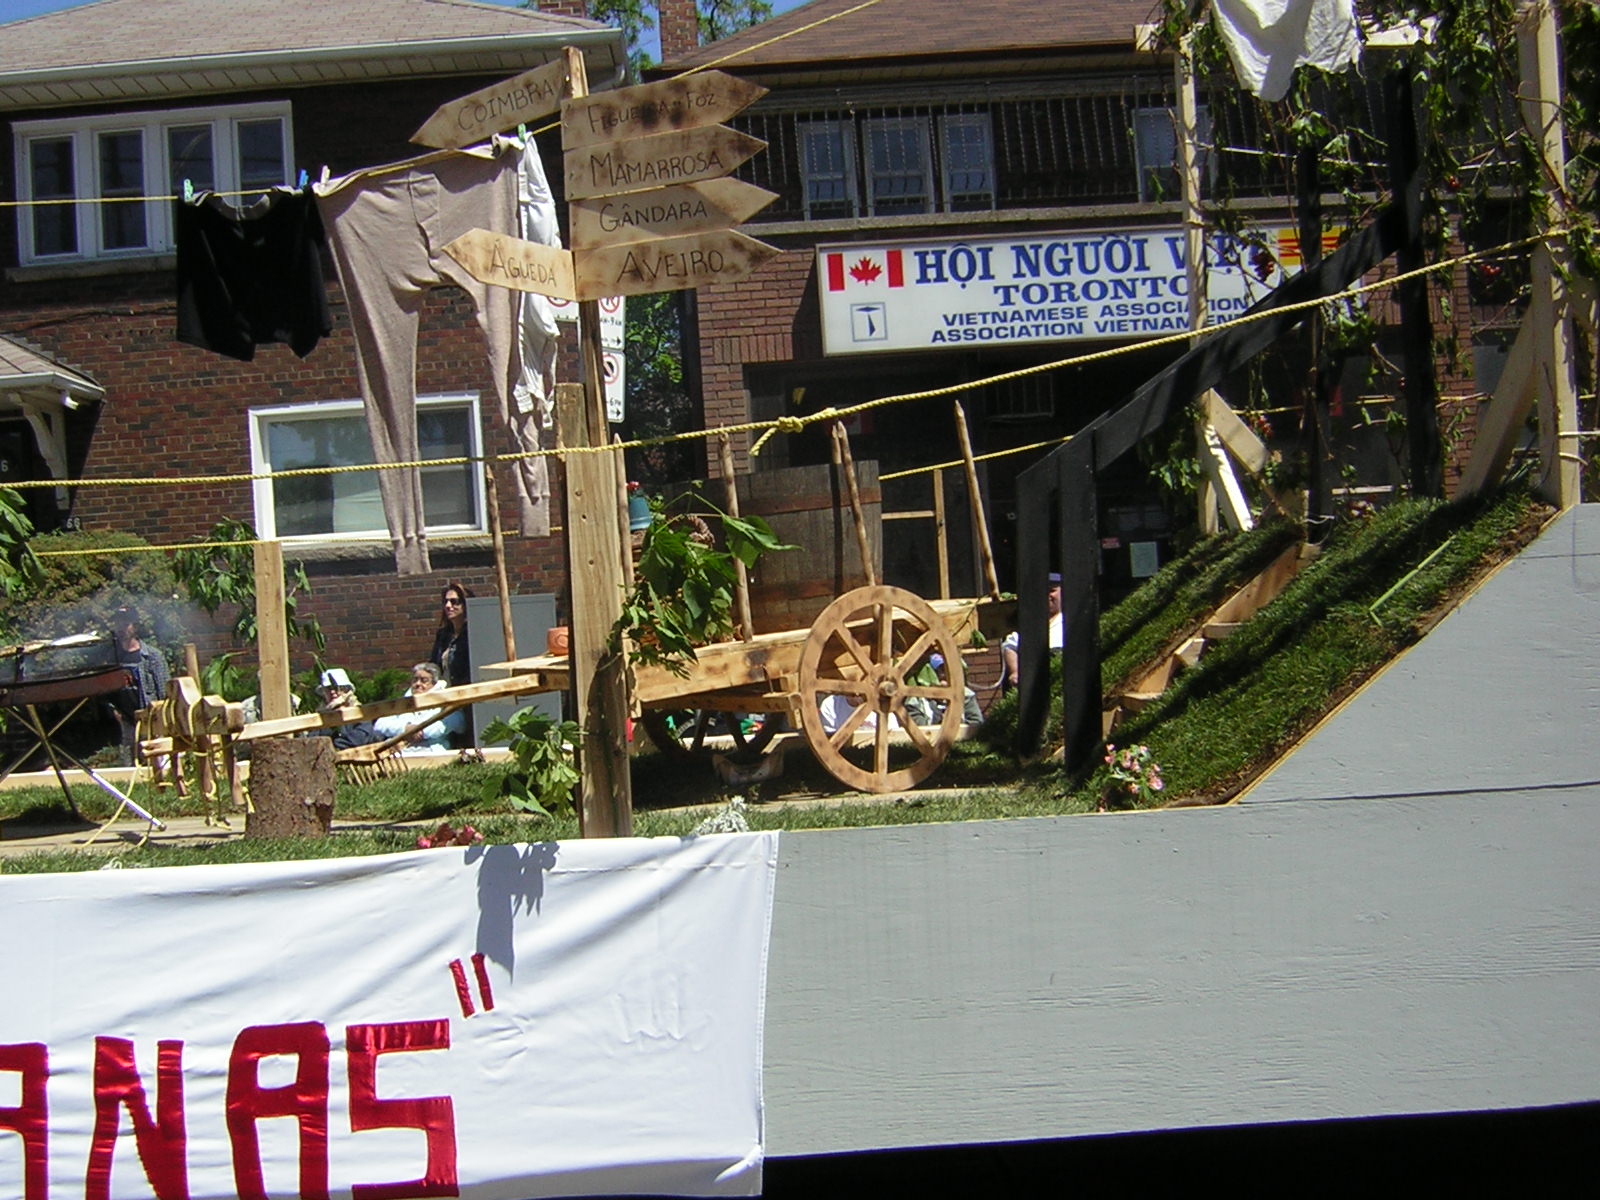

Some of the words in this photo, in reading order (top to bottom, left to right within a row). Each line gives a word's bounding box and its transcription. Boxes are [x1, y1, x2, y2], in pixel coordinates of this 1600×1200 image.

[457, 81, 555, 131] COIMBRA
[686, 92, 718, 110] FOZ
[590, 151, 724, 188] MAMARROSA
[599, 200, 708, 233] GÂNDARA
[616, 250, 724, 283] AVEIRO
[993, 273, 1188, 307] TORONTO
[931, 321, 1083, 343] ASSOCIATION
[942, 305, 1088, 327] VIETNAMESE
